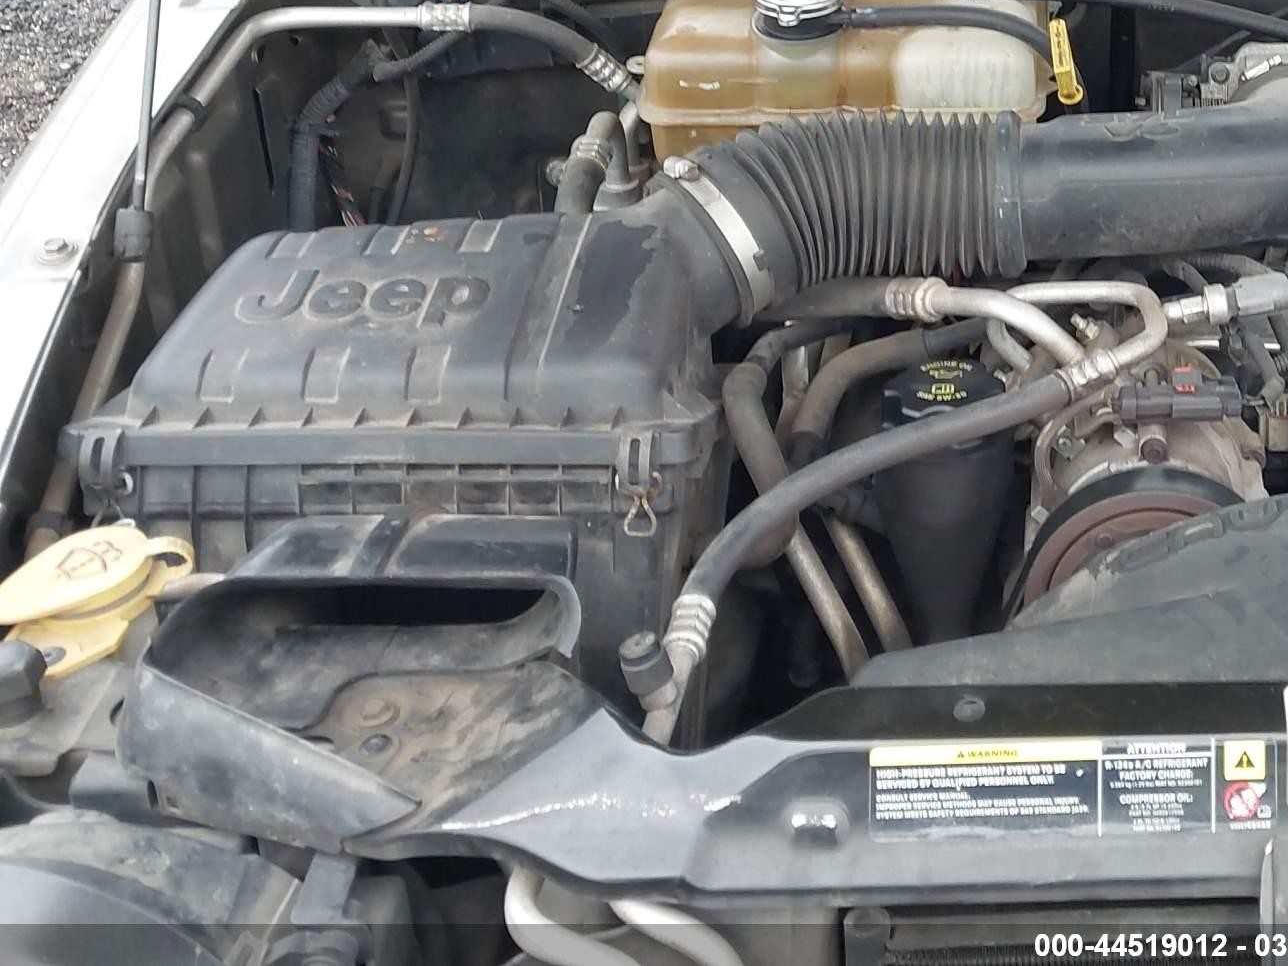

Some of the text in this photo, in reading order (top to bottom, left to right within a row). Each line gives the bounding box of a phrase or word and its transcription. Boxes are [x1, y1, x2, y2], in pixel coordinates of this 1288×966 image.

[234, 268, 491, 330] Jeep
[920, 360, 958, 371] ENGINE
[967, 749, 1018, 758] WARNING
[1126, 743, 1187, 755] ATTENTION
[1152, 757, 1209, 769] REFRIGERANT
[947, 765, 1006, 778] REFRIGERANT
[1006, 764, 1040, 776] SYSTEM
[1041, 764, 1053, 775] TO
[1119, 770, 1157, 781] FACTORY
[876, 778, 918, 790] SERVICED
[919, 778, 930, 789] BY
[932, 777, 978, 789] QUALIFIED
[978, 776, 1029, 787] PERSONNEL
[876, 793, 909, 803] CONSULT
[1119, 793, 1176, 805] COMPRESSOR
